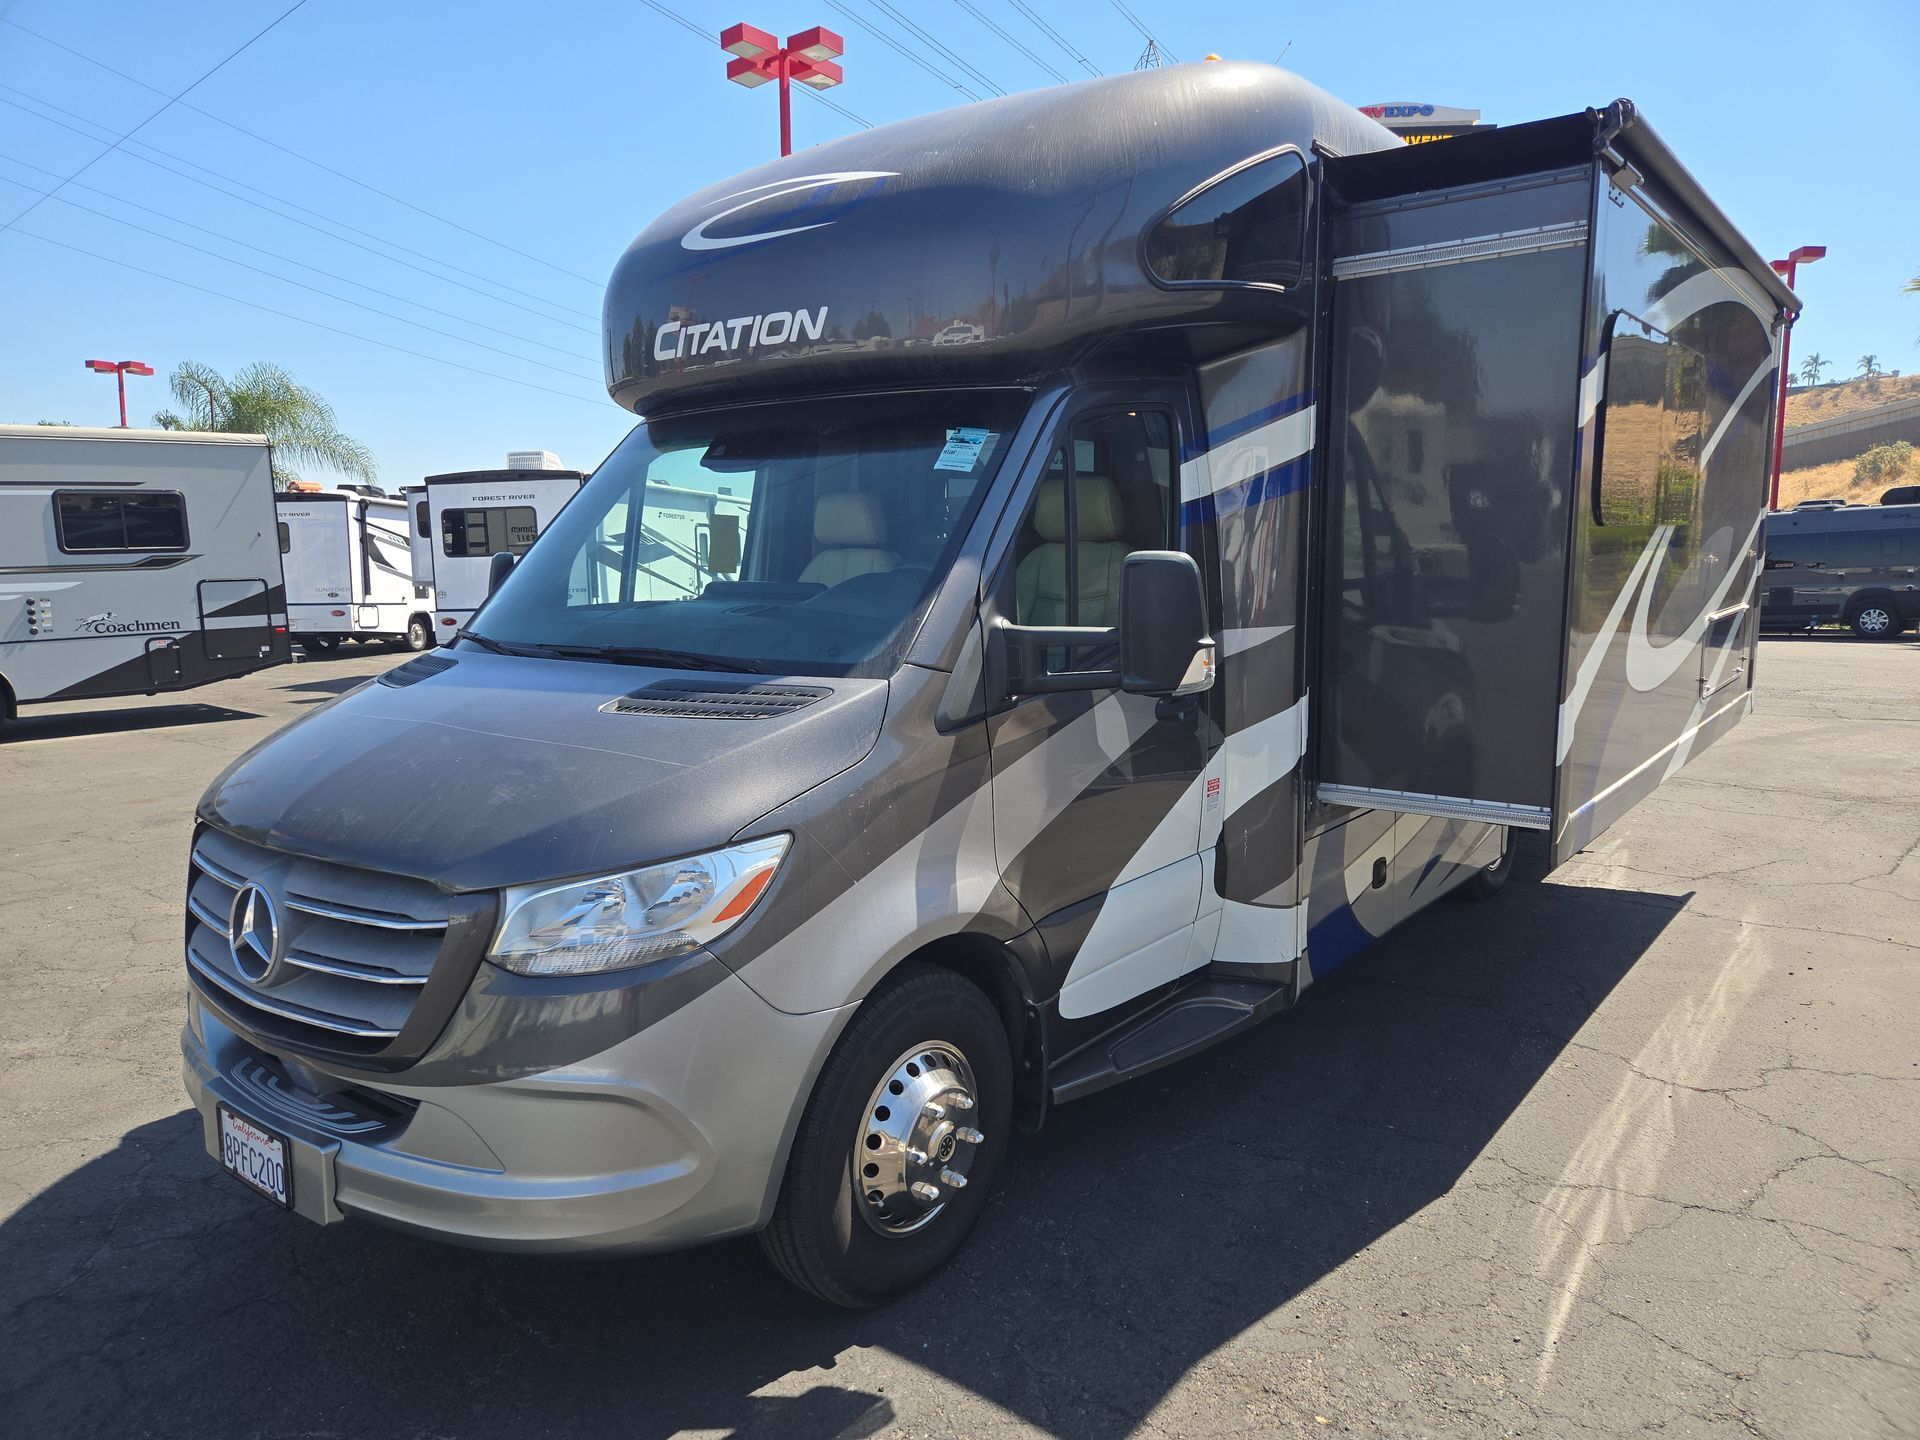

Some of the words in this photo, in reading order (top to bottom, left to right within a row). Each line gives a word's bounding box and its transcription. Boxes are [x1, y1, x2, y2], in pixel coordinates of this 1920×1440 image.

[653, 306, 828, 362] CITATION
[94, 619, 180, 634] Coachmen
[225, 1132, 285, 1196] 8PFC200
